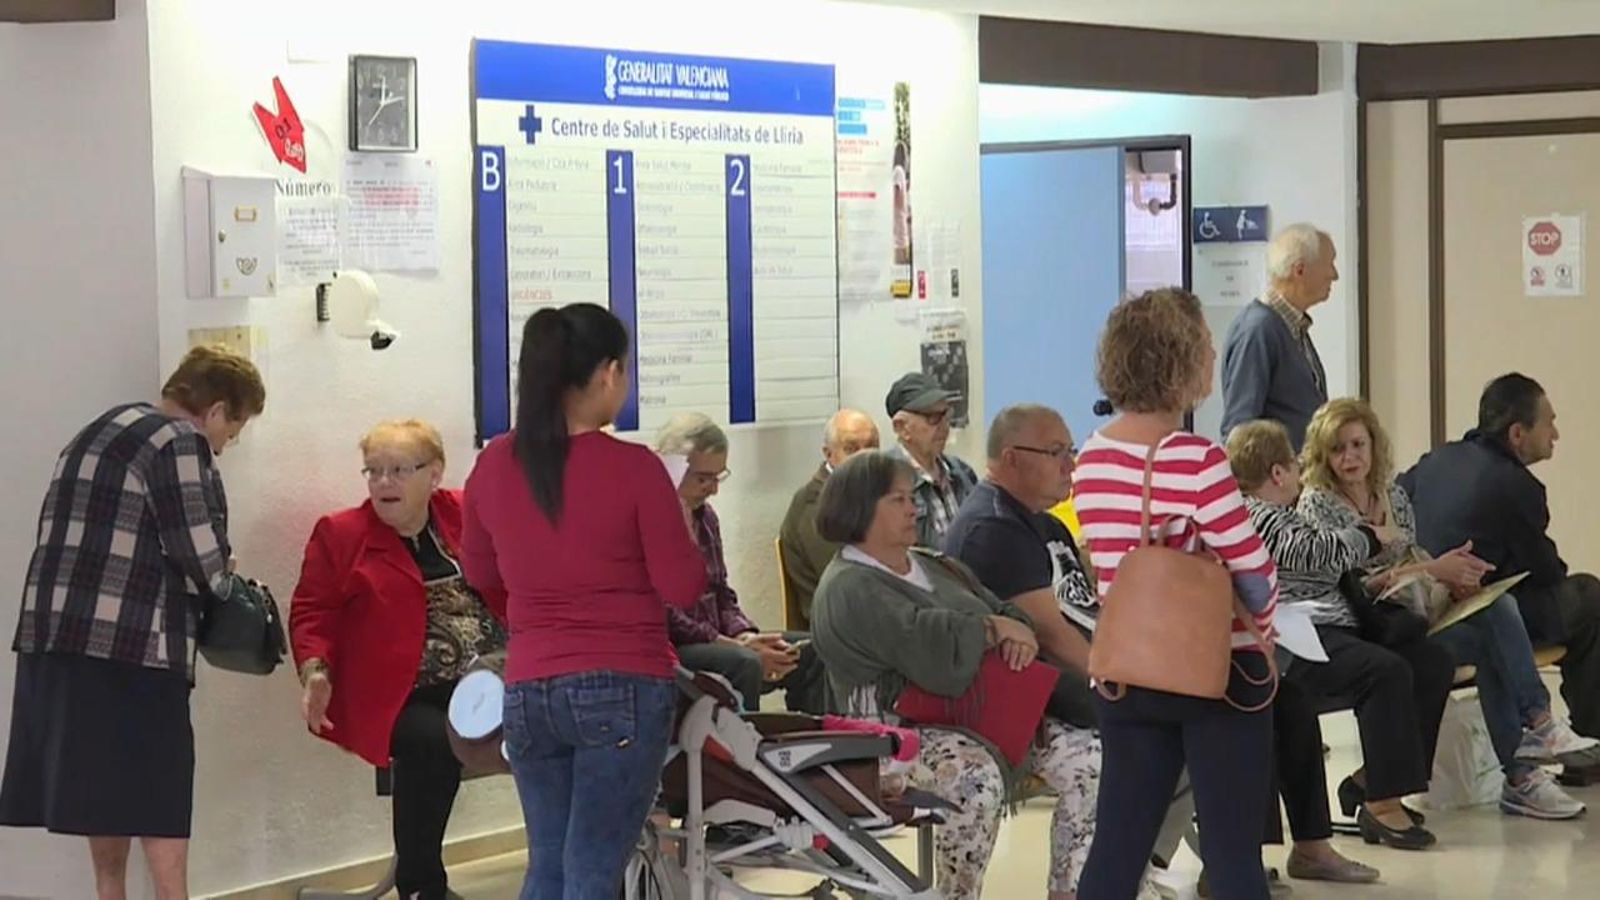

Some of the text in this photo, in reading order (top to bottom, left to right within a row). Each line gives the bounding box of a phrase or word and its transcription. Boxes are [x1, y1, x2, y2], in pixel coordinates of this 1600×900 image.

[618, 60, 730, 89] GENERALITAT VALENCIANA
[551, 117, 598, 137] Centre
[602, 119, 620, 138] de
[623, 119, 658, 139] Salut
[662, 121, 667, 140] i
[670, 122, 751, 146] Especialitats
[754, 125, 770, 144] de
[482, 151, 501, 191] B
[612, 156, 628, 194] 1
[730, 158, 746, 196] 2
[1530, 232, 1559, 246] STOP
